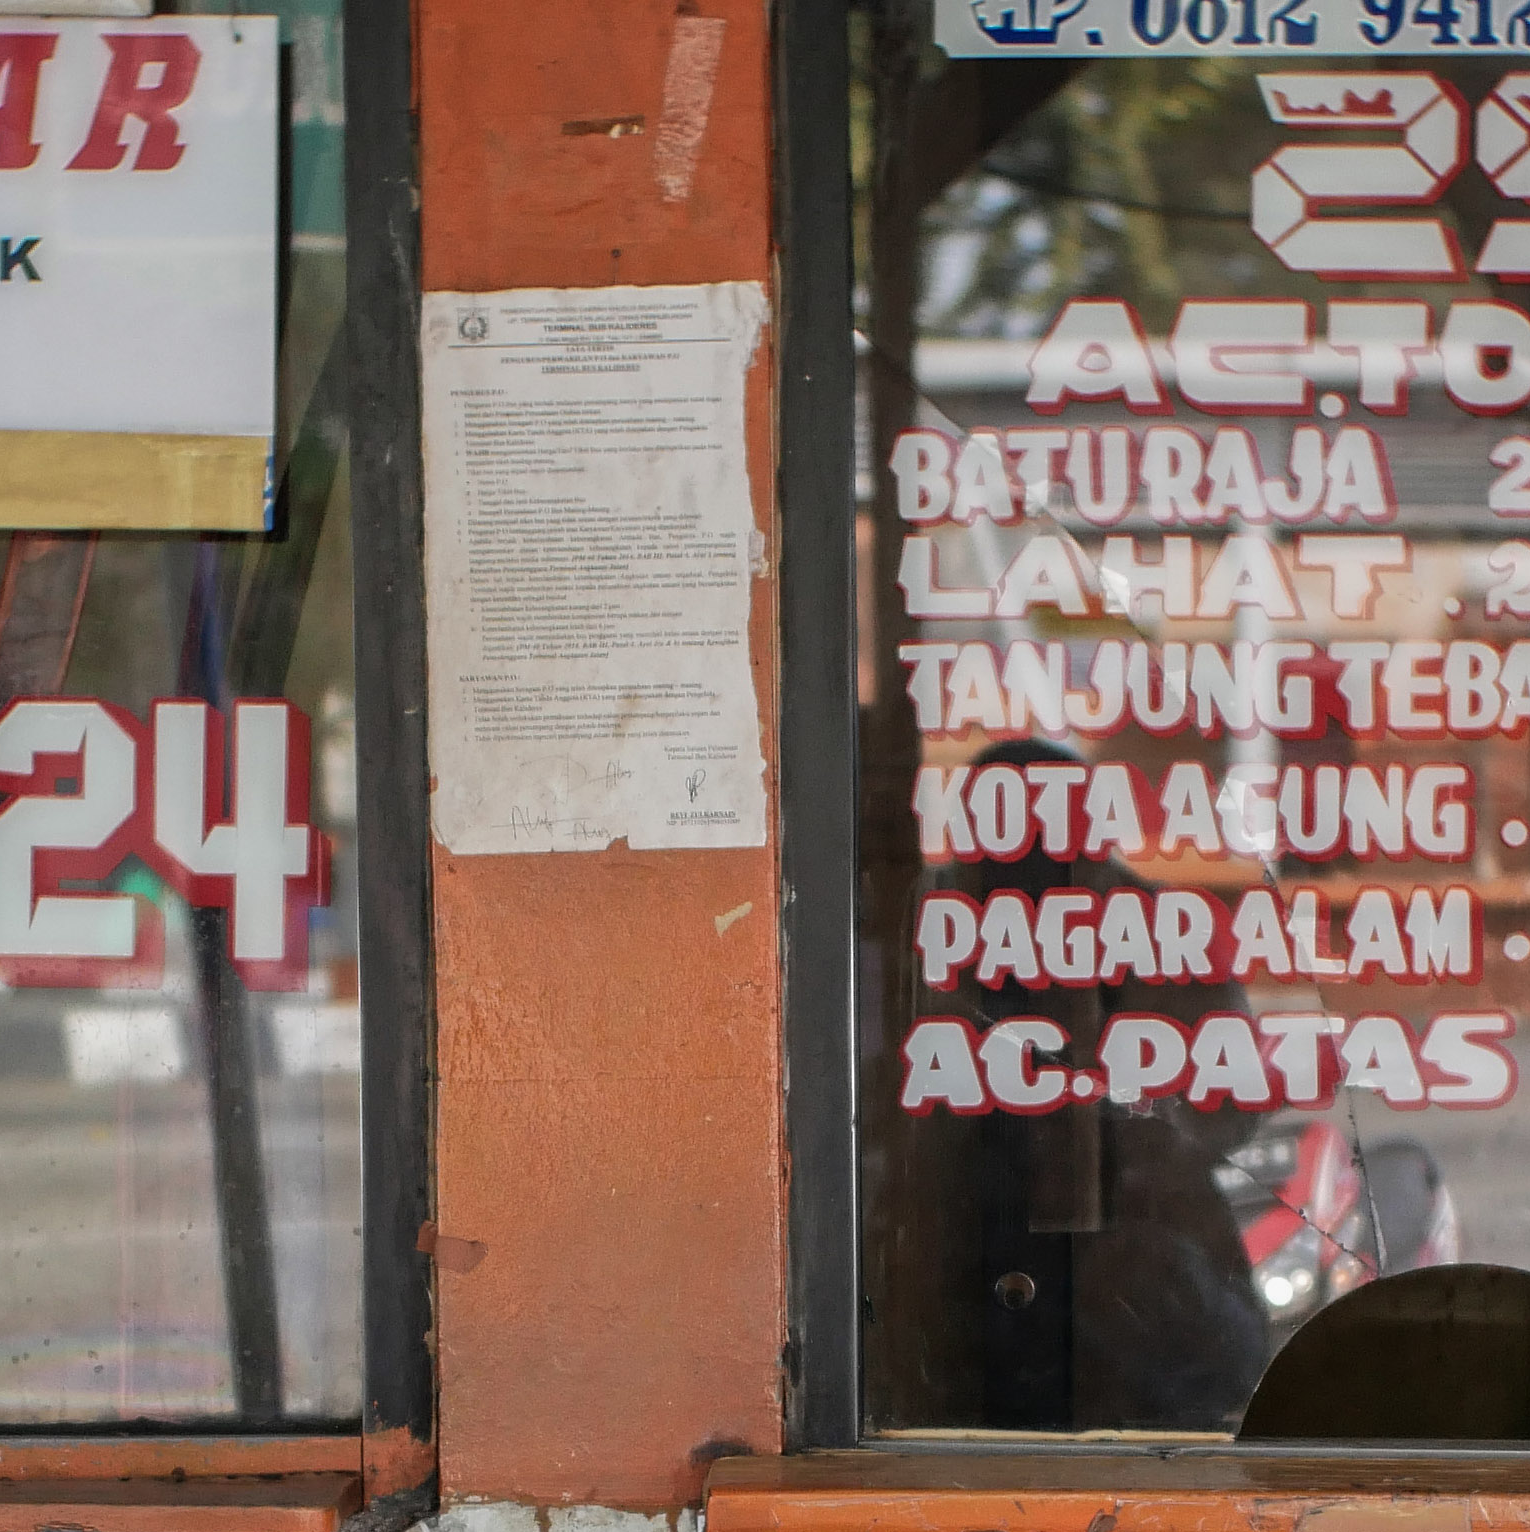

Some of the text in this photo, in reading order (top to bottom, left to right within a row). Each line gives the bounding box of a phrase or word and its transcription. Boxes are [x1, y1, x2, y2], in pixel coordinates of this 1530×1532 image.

[890, 424, 1399, 525] BATURAJA
[896, 533, 1414, 621] LAHAT
[898, 640, 1321, 741] TANJUNG
[914, 761, 1153, 861] KOTA
[1160, 761, 1476, 862] AGUNG
[917, 886, 1219, 989] PAGAR
[1231, 885, 1483, 985] ALAM
